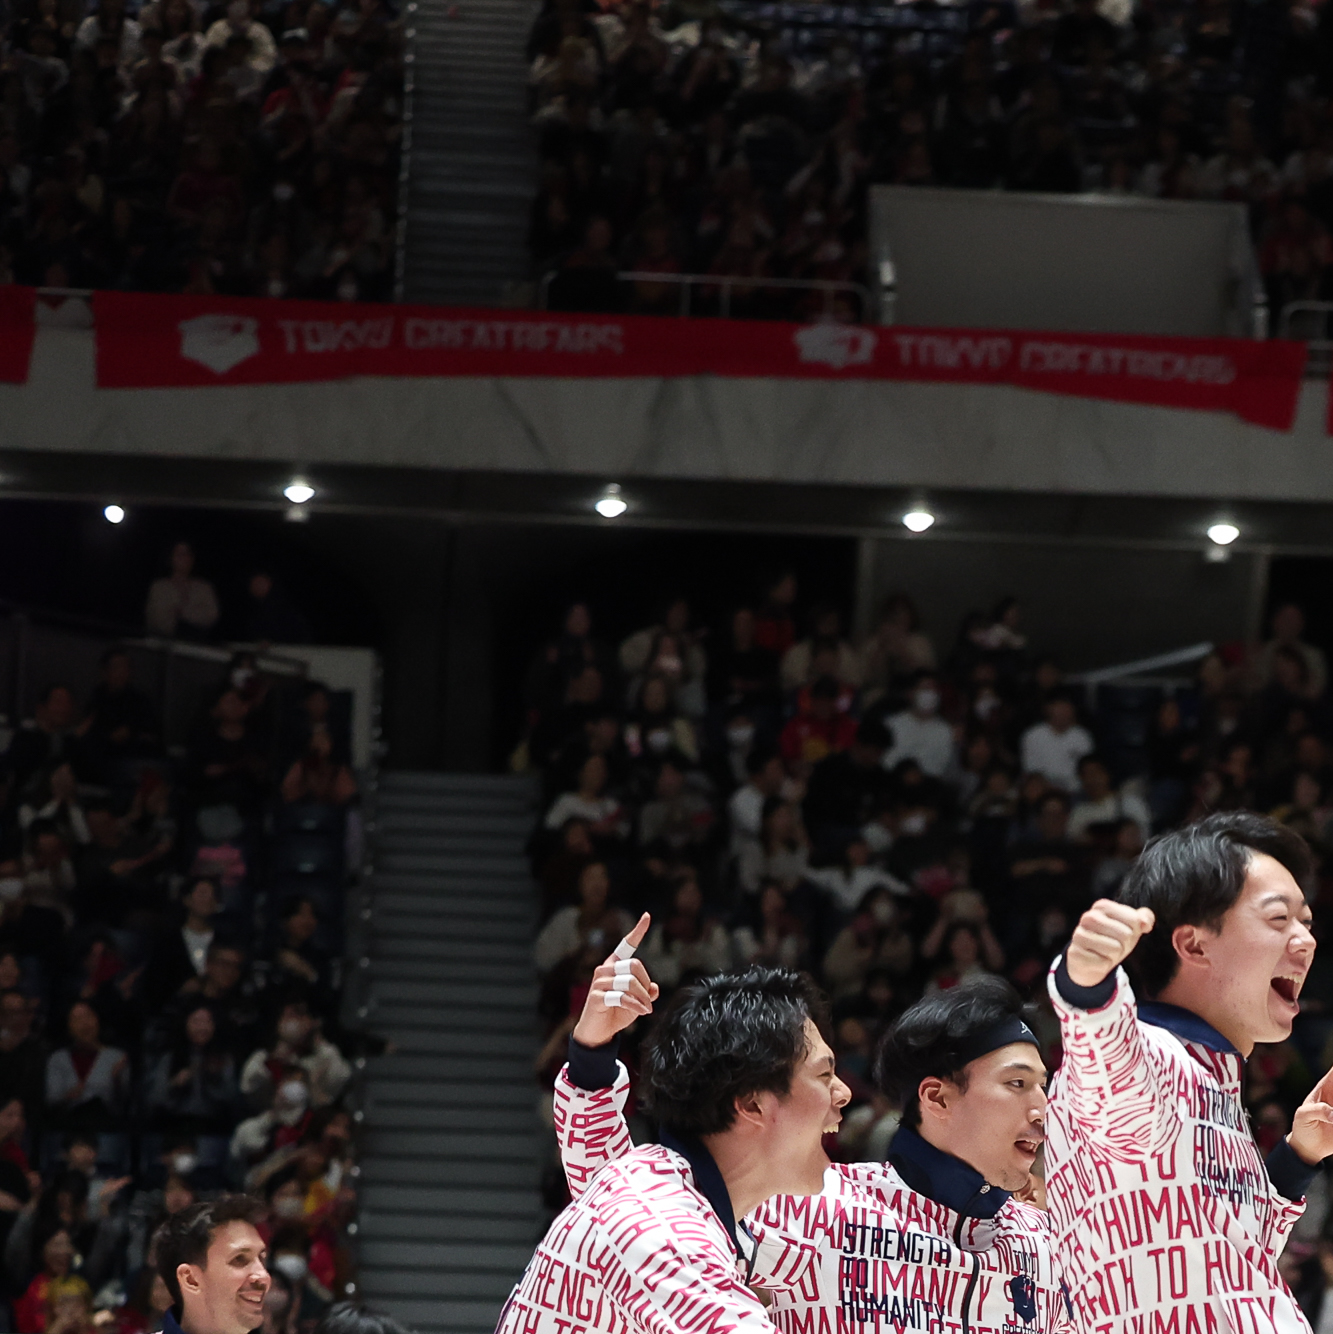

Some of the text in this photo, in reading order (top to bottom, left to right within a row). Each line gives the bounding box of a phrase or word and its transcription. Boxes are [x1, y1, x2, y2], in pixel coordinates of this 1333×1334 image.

[843, 1223, 952, 1269] STRENGTH
[843, 1256, 869, 1289] TO
[1147, 1245, 1188, 1302] TO
[841, 1290, 945, 1334] HUMANITY
